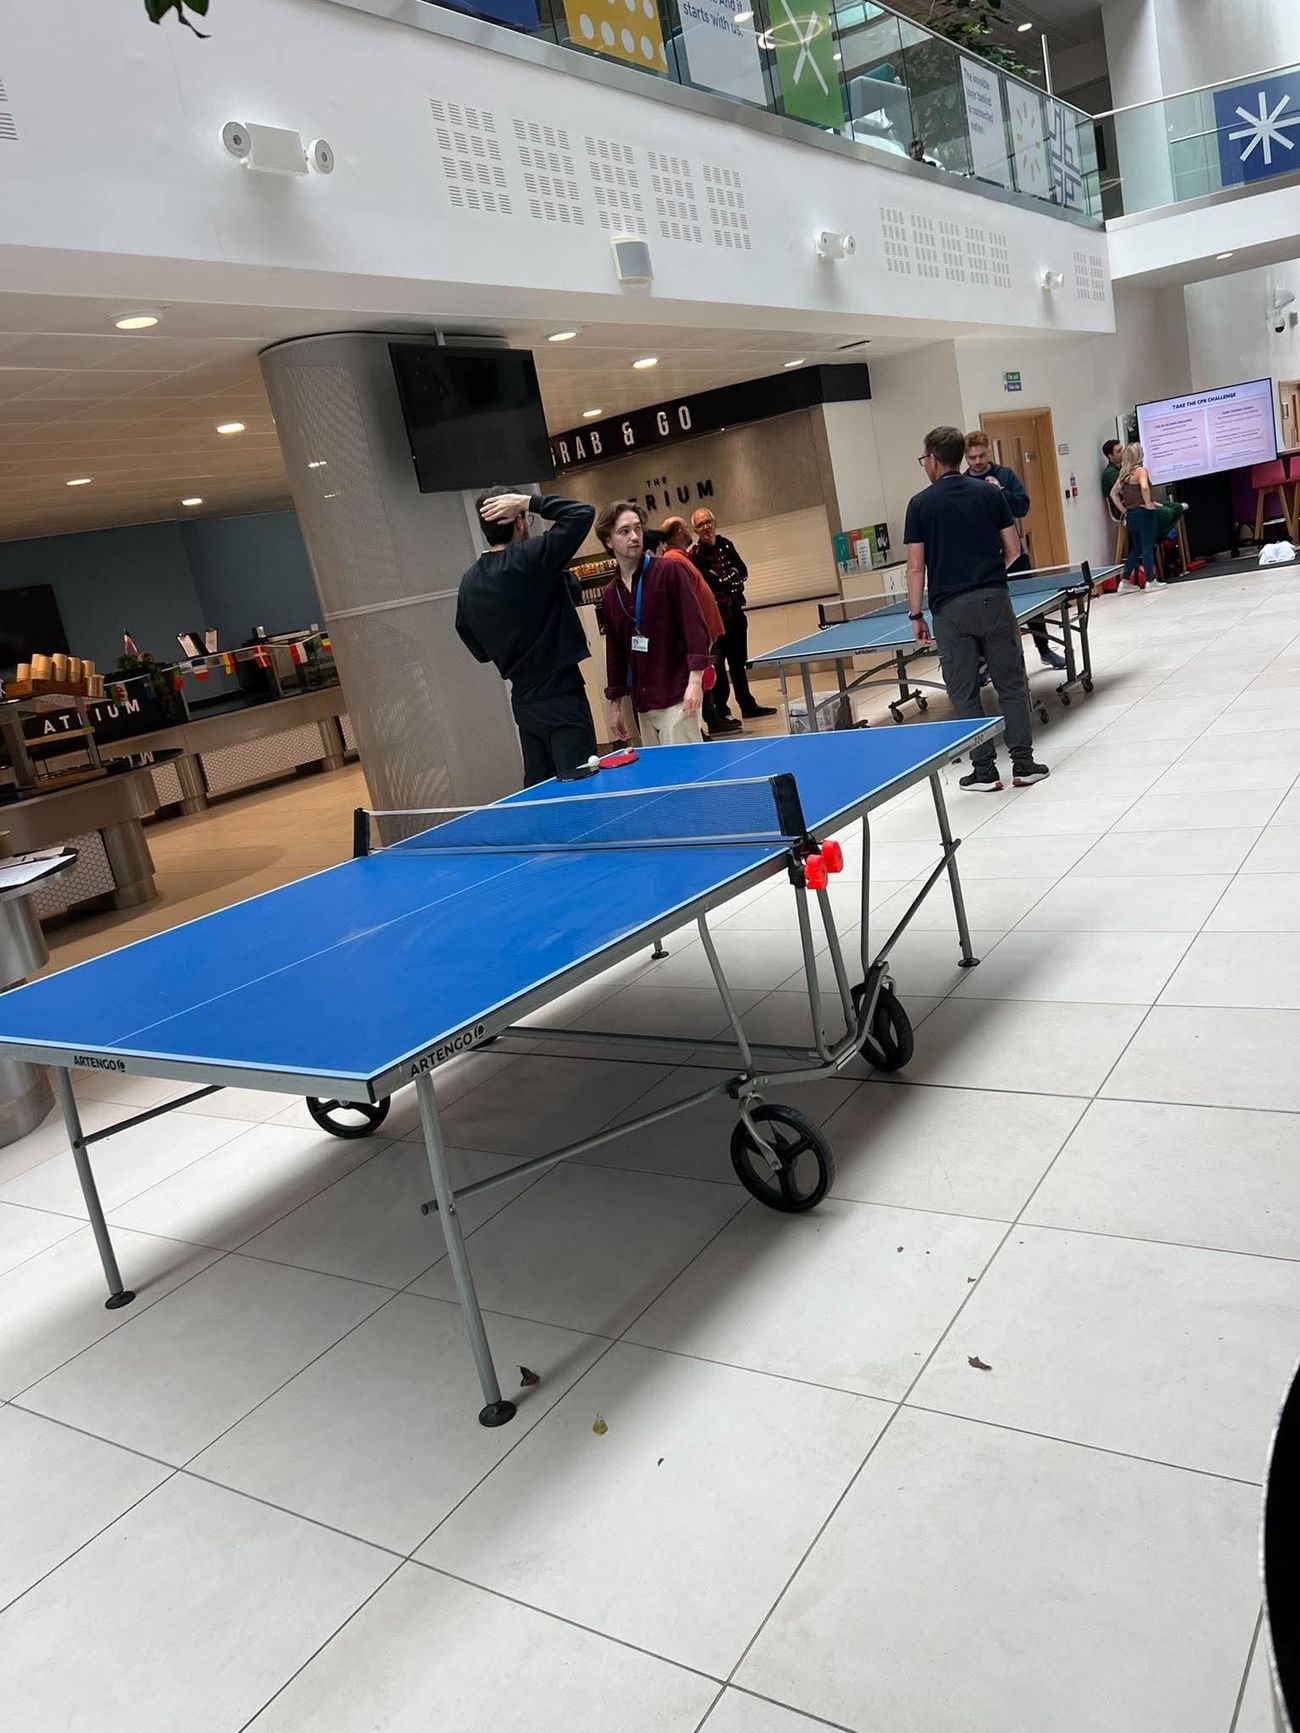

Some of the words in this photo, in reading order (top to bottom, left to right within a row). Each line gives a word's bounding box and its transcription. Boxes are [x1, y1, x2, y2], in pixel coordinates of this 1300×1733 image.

[683, 2, 709, 24] starts
[710, 13, 730, 32] with
[731, 24, 744, 37] us.
[1208, 392, 1236, 403] CHALLENGE
[622, 421, 635, 446] &
[656, 405, 692, 436] GO
[627, 479, 715, 512] RIUM
[646, 476, 668, 488] THE
[74, 1055, 117, 1070] ARTENGO
[410, 1032, 473, 1078] ARTENGO
